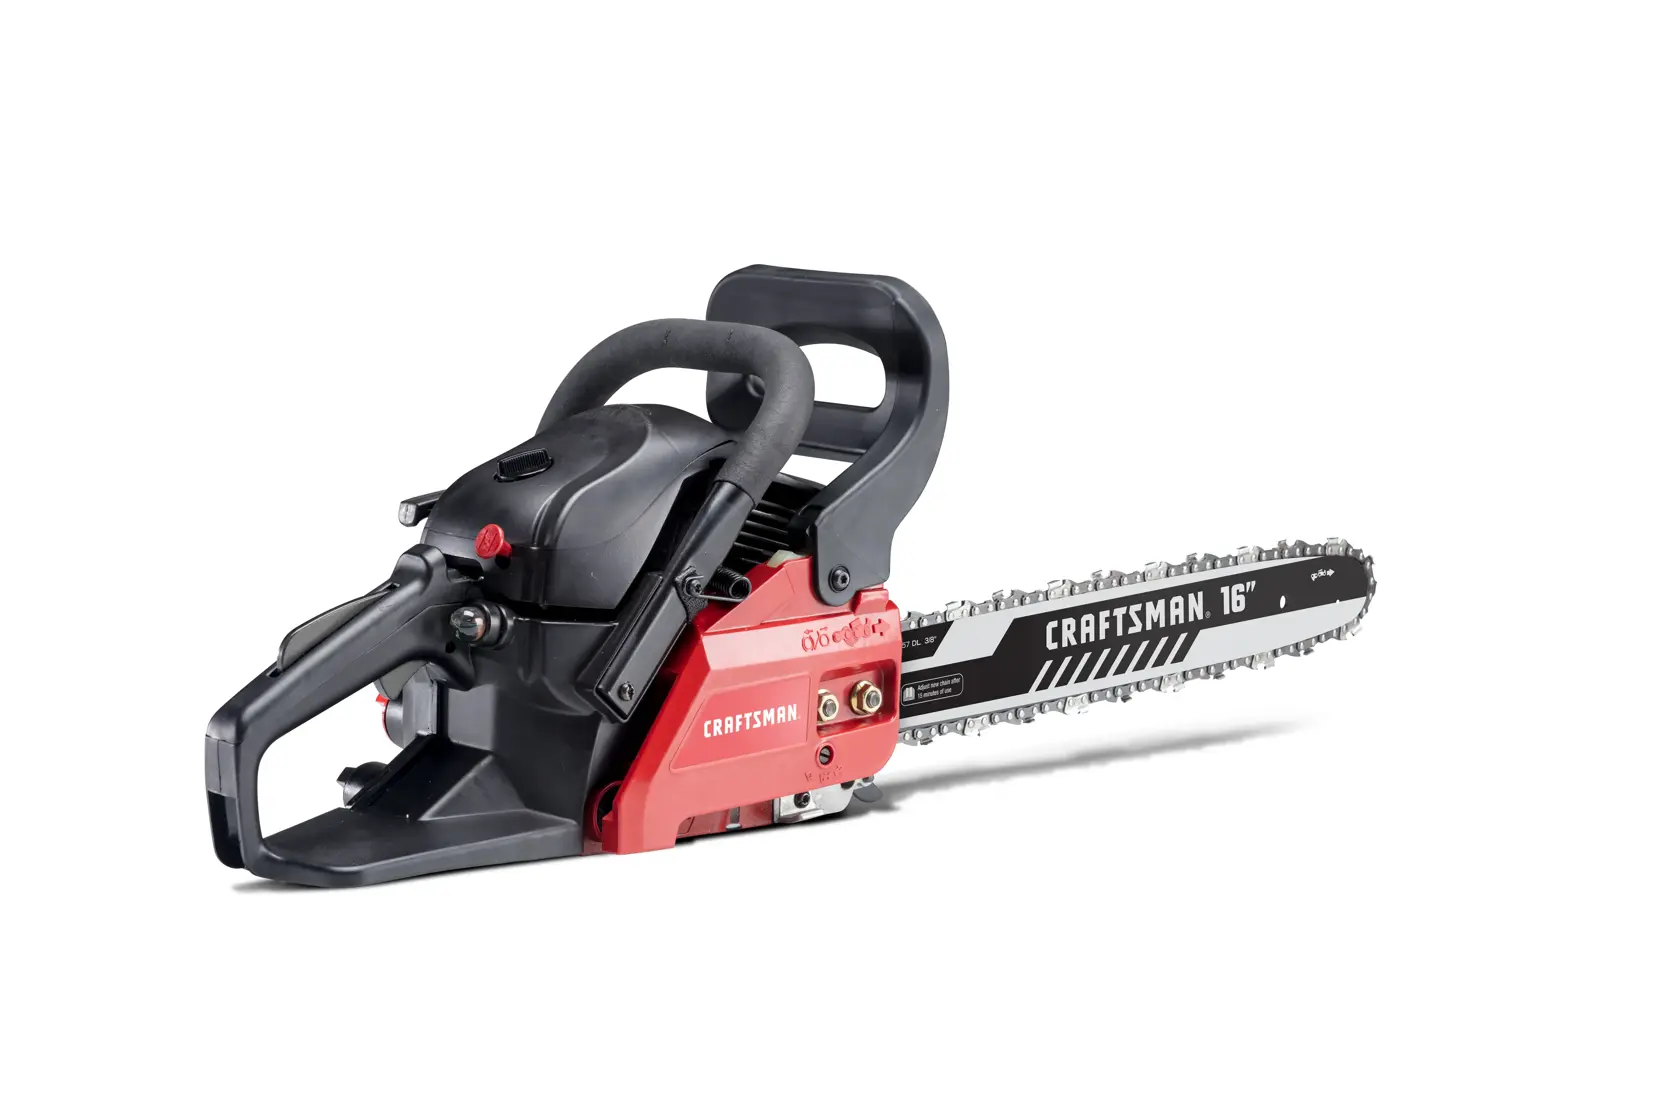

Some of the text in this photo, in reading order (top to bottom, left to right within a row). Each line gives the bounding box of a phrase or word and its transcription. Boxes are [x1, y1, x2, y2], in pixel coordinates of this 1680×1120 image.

[911, 639, 921, 647] DL
[917, 683, 930, 691] Adjust
[703, 704, 797, 738] CRAFTSMAN
